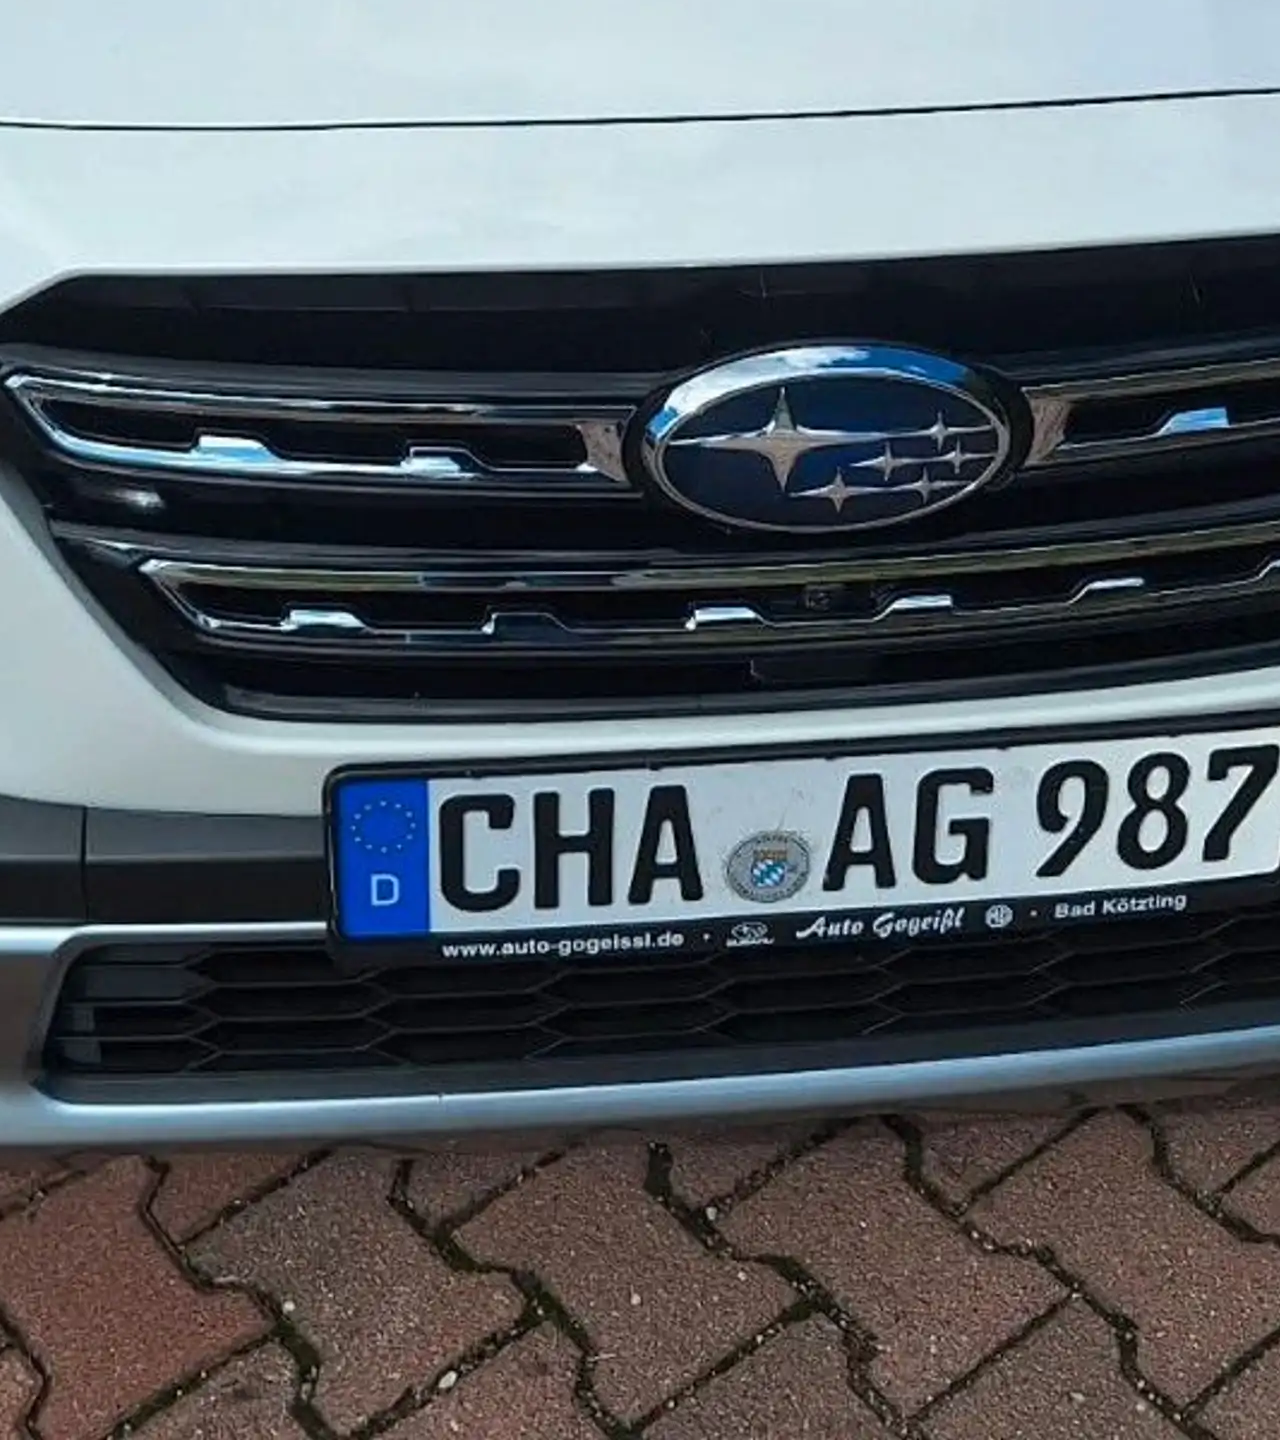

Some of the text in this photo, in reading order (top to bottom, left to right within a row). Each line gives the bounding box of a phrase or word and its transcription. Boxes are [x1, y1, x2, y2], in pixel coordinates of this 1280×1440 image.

[439, 784, 704, 913] CHA
[822, 767, 995, 891] AG
[1035, 743, 1280, 878] 987
[370, 873, 400, 906] D
[441, 931, 685, 958] www.auto-gogeissl.de
[795, 916, 865, 940] Auto
[1053, 900, 1096, 919] Bad
[1101, 893, 1188, 912] Kötzting
